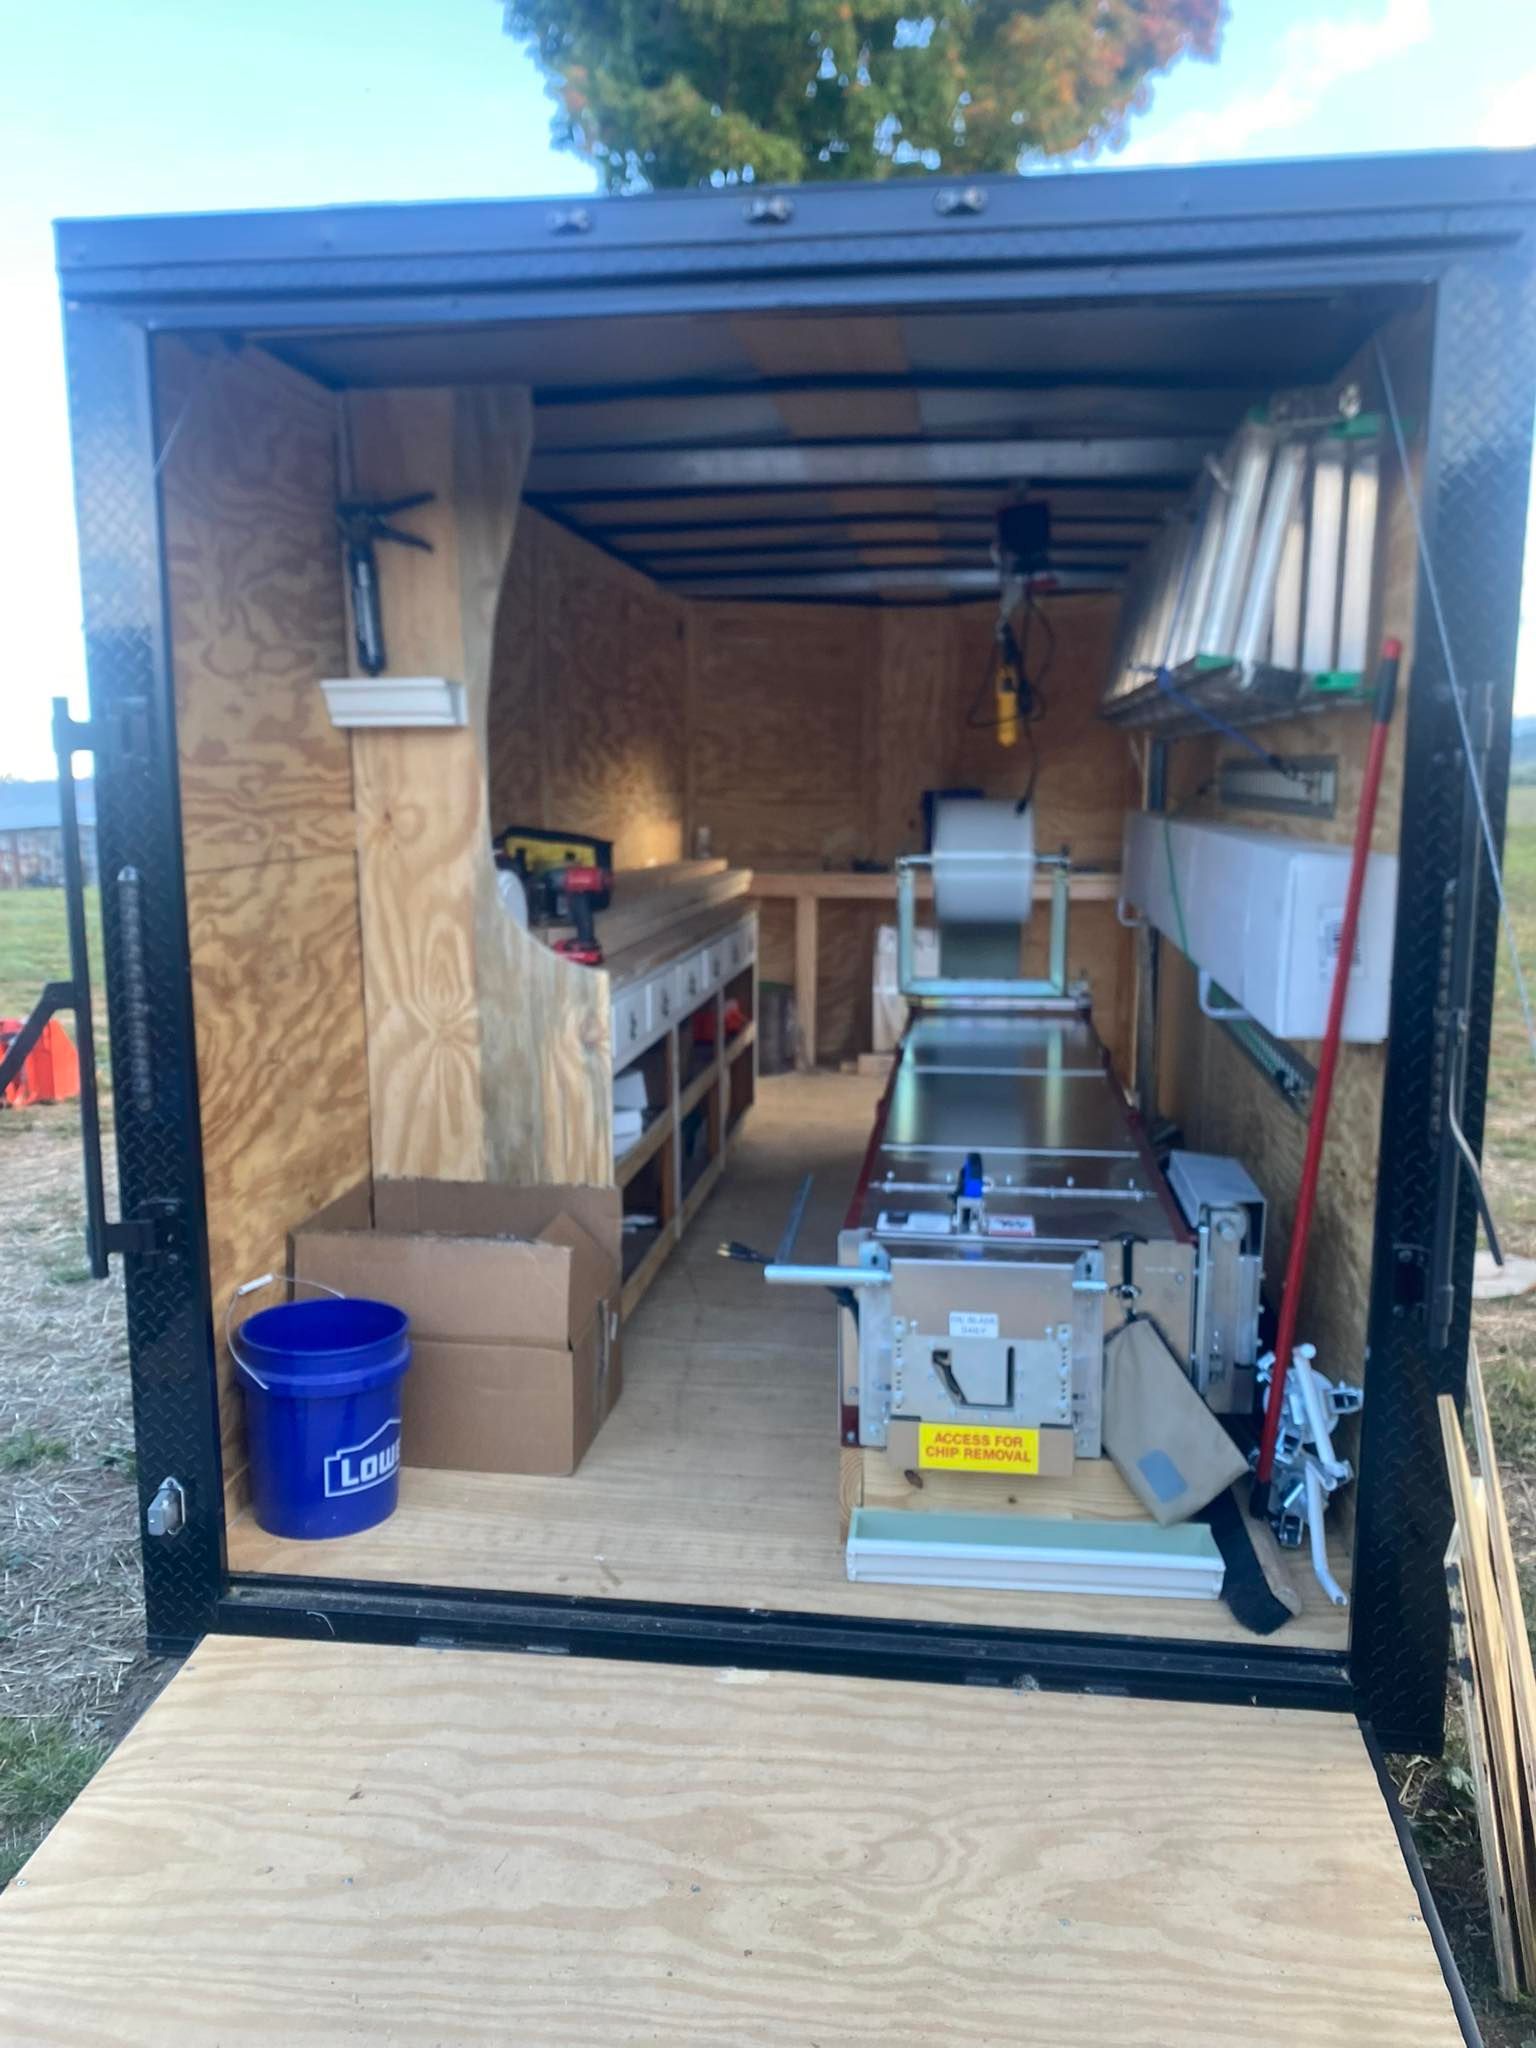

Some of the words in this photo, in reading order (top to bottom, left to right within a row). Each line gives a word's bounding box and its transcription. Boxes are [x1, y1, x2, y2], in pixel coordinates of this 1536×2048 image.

[934, 1432, 990, 1447] ACCESS
[994, 1435, 1023, 1448] FOR
[925, 1445, 959, 1459] CHIP
[963, 1447, 1031, 1463] REMOVAL
